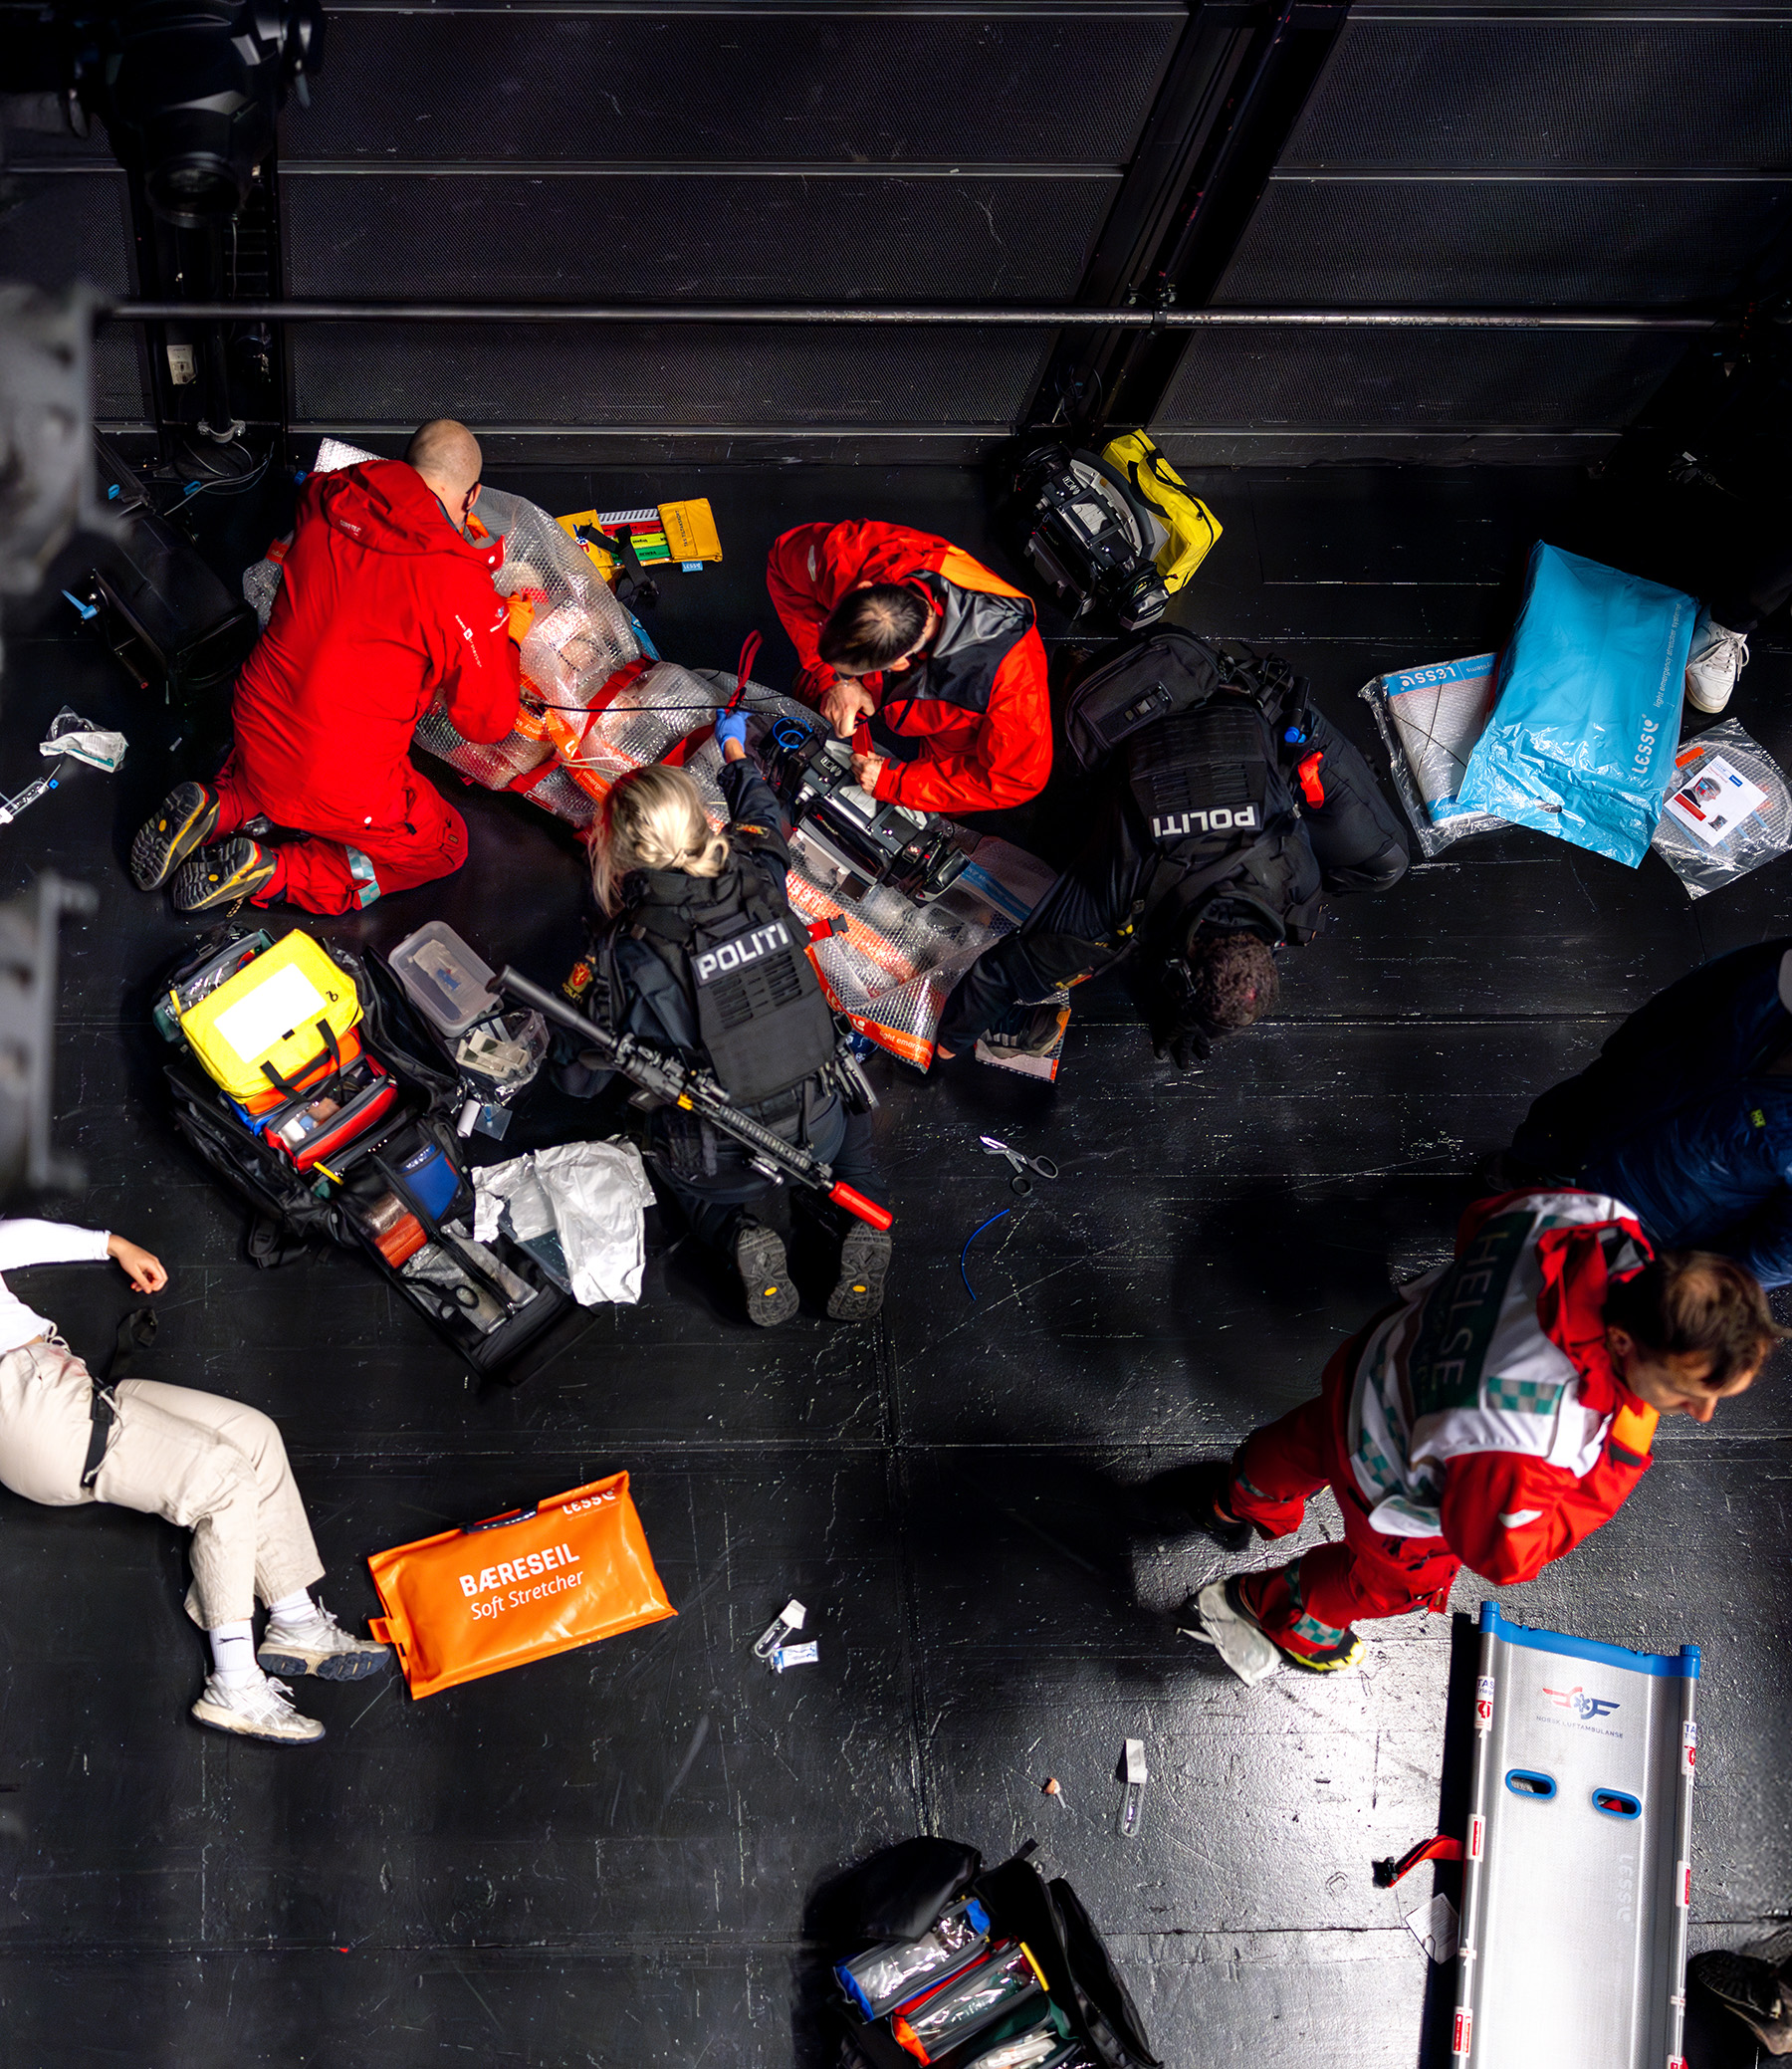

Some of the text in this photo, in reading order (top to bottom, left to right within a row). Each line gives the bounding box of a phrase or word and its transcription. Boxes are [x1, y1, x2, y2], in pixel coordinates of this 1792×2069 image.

[1653, 603, 1681, 709] light emergency stretcher systems
[1152, 805, 1255, 838] POLITI
[696, 922, 788, 981] POLITI
[1432, 1232, 1510, 1391] HELSE
[458, 1543, 580, 1597] BÆRESEIL
[470, 1570, 584, 1620] Soft Stretcher
[1536, 1715, 1624, 1739] NORSK LUFTAMBULANSE
